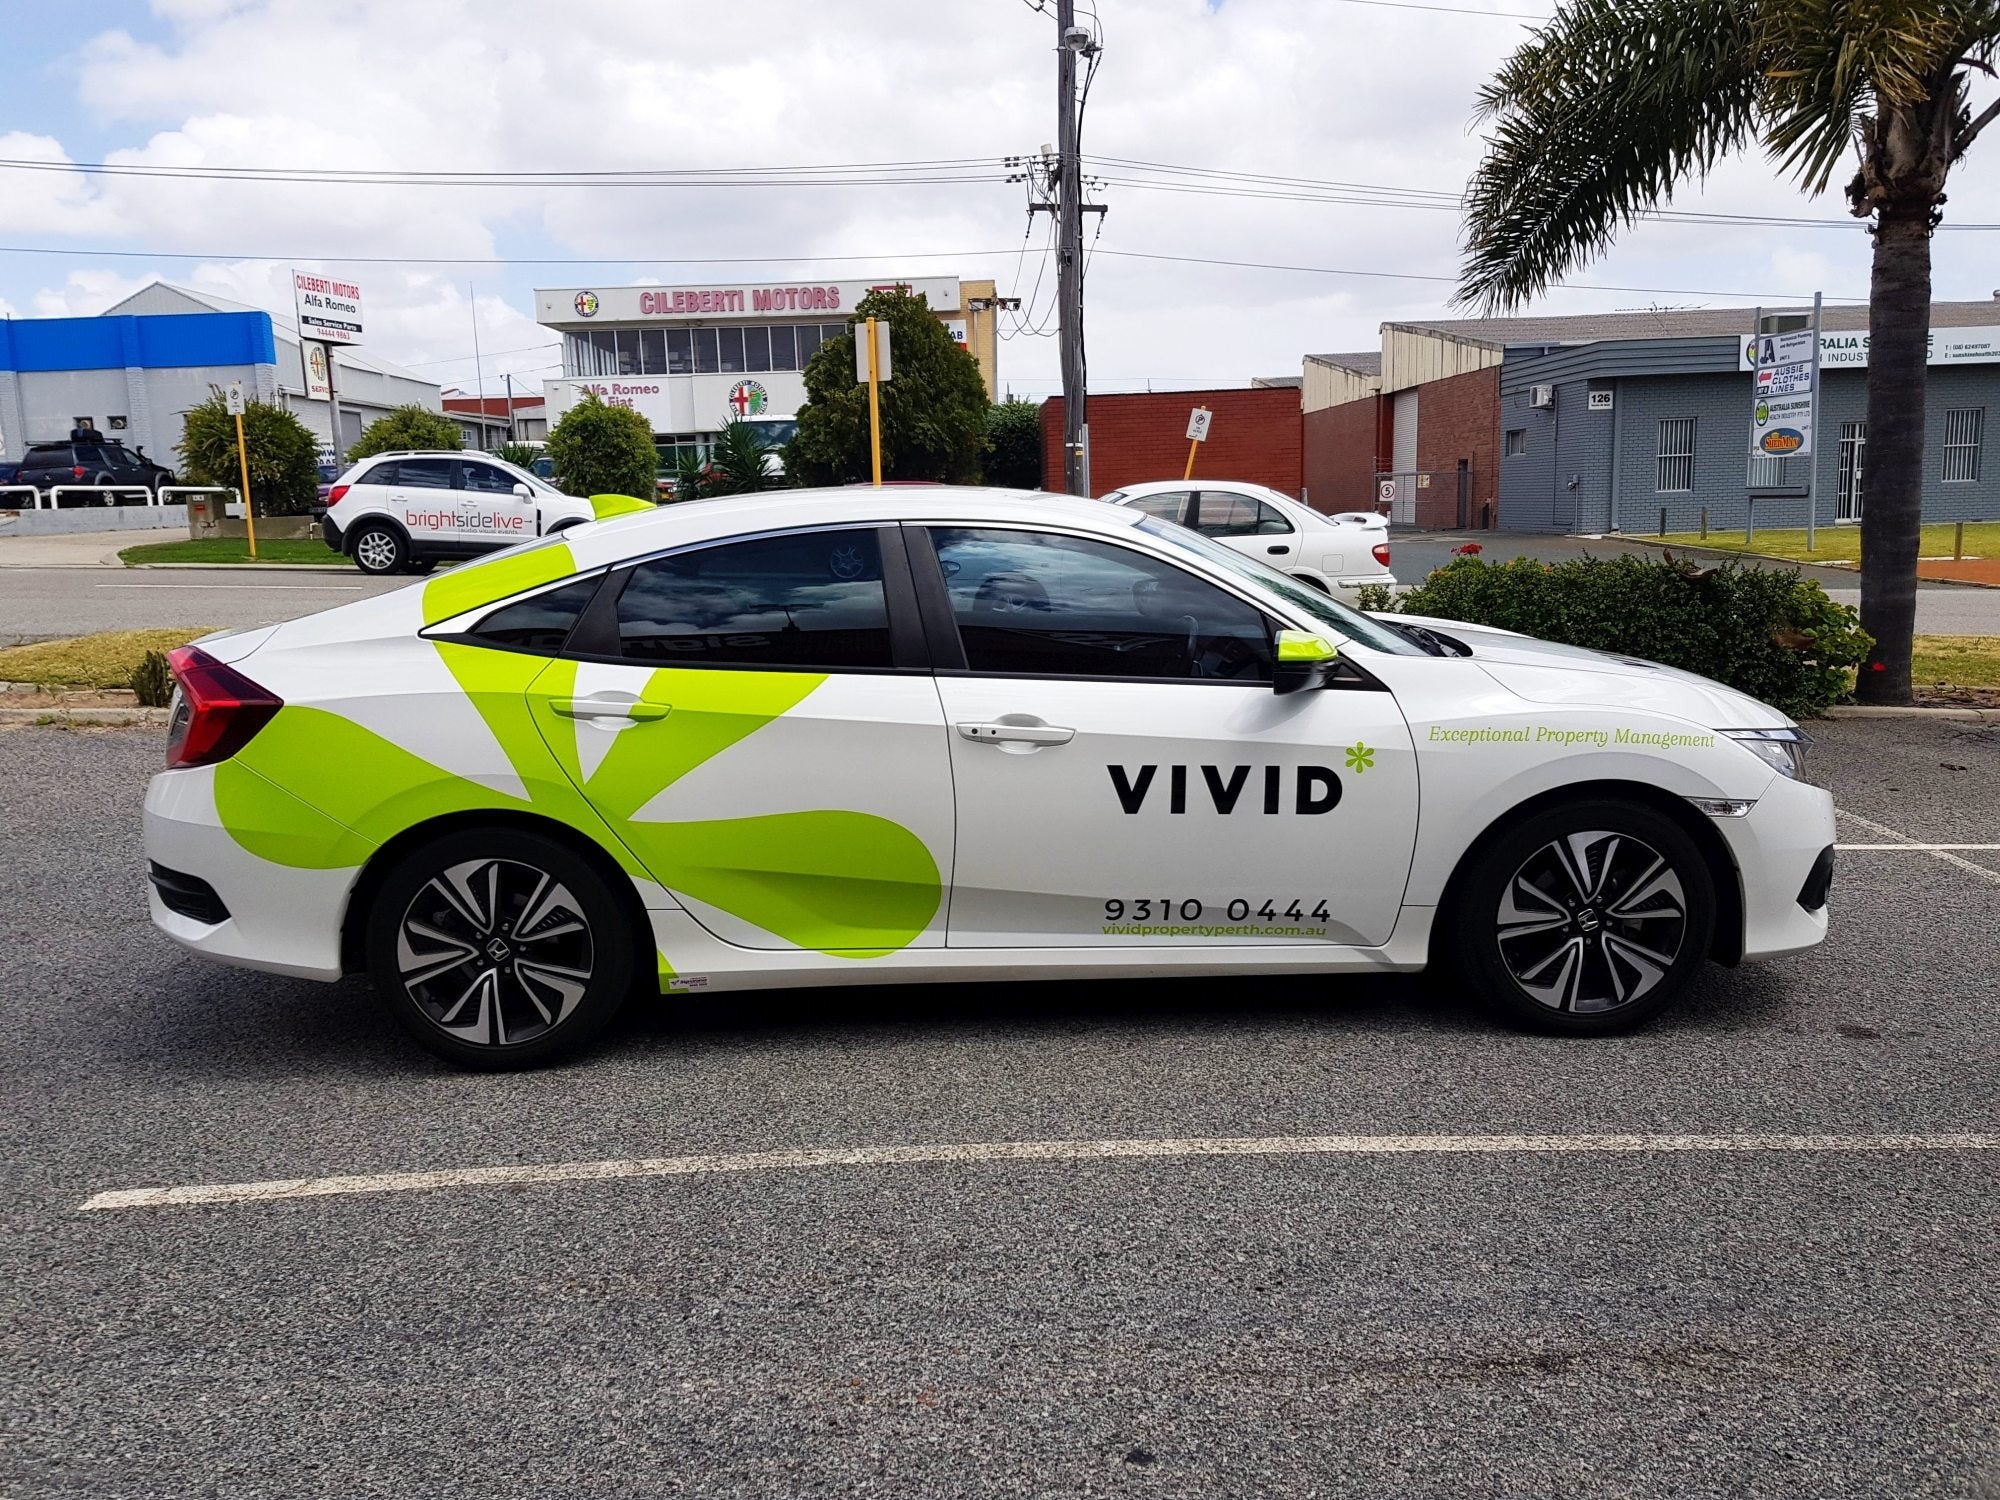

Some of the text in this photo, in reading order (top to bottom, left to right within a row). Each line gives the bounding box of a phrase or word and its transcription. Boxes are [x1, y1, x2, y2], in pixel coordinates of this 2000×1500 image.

[296, 275, 360, 300] CILEBERTI MOTORS
[304, 294, 356, 313] Alfa Romeo
[639, 286, 840, 314] CILEBERTI MOTORS
[1774, 365, 1804, 376] AUSSIE
[1772, 372, 1810, 385] CLOTHES
[612, 383, 660, 395] Romeo
[1770, 383, 1795, 393] LINES
[607, 396, 634, 407] Fiat
[1591, 394, 1611, 403] 126
[1791, 400, 1810, 409] SUNSHINE
[406, 509, 523, 530] brightsidelive
[1428, 725, 1715, 749] Exceptional Property Management
[1106, 764, 1343, 815] VIVID
[1104, 898, 1331, 923] 9310 0444
[1101, 922, 1328, 937] vividpropertyperth.com.au
